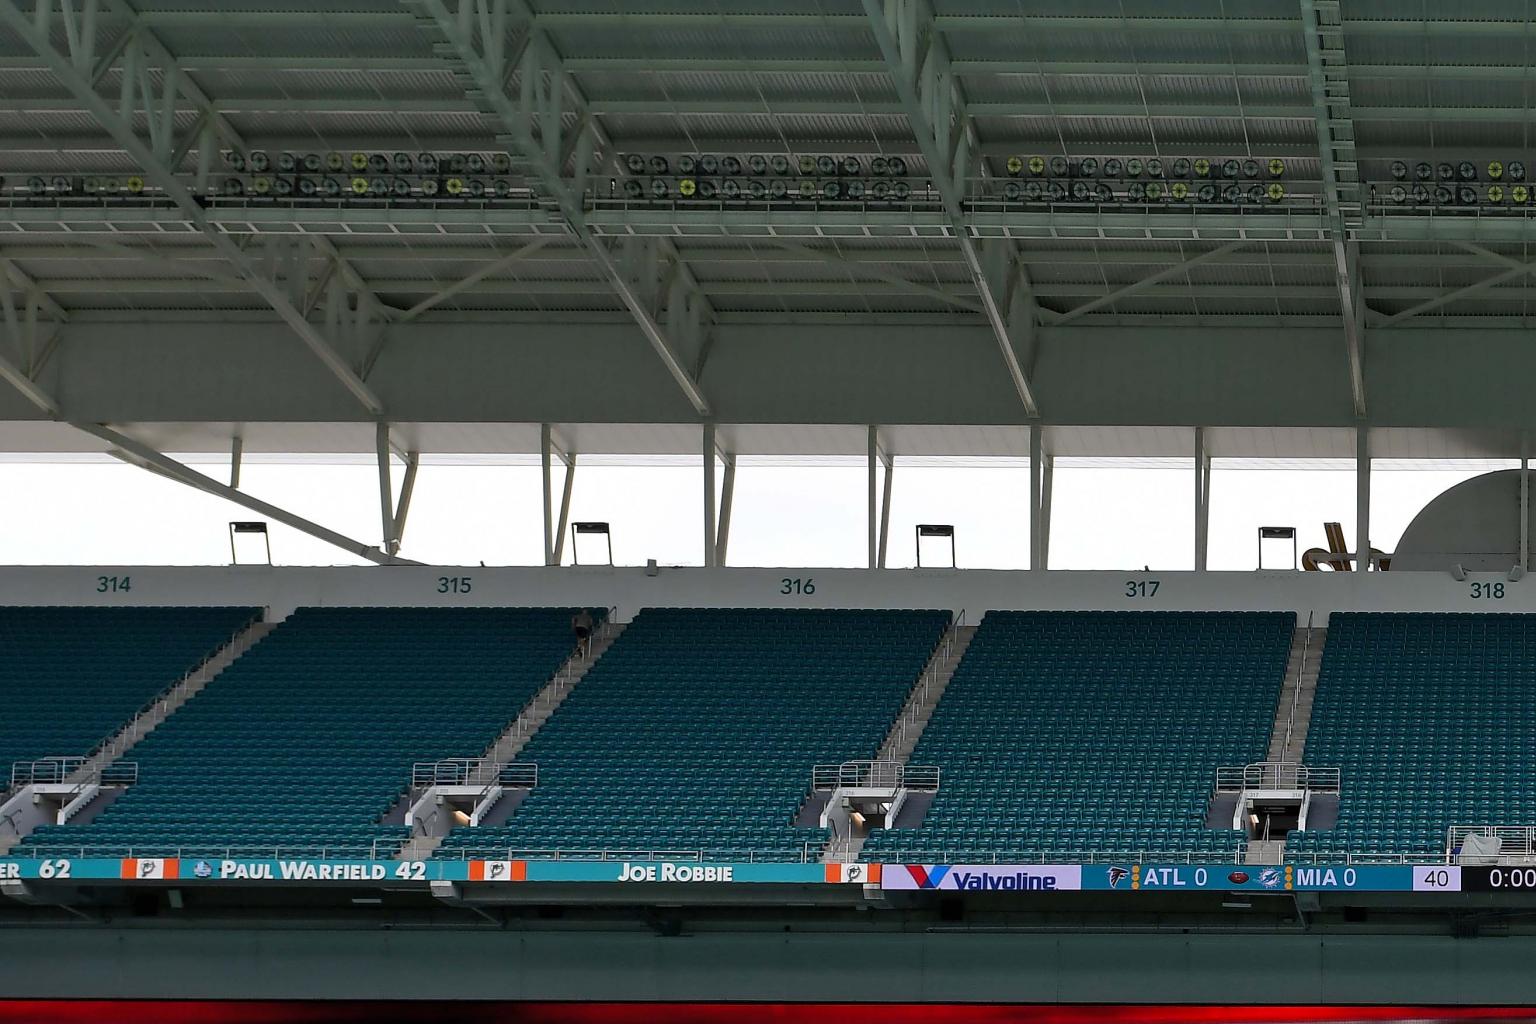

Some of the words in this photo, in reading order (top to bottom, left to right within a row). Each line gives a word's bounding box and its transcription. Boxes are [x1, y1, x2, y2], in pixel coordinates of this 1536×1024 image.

[97, 576, 131, 592] 314
[437, 577, 472, 593] 315
[780, 578, 815, 595] 316
[1125, 581, 1160, 597] 317
[1470, 582, 1505, 599] 318
[39, 859, 71, 879] 62
[395, 862, 426, 881] 42
[1144, 868, 1186, 886] ATL
[1195, 867, 1208, 887] 0
[1297, 868, 1337, 886] MIA
[1344, 867, 1357, 888] 0
[952, 872, 1056, 890] Valvoline
[1424, 870, 1449, 887] 40
[1490, 869, 1536, 888] 0:00
